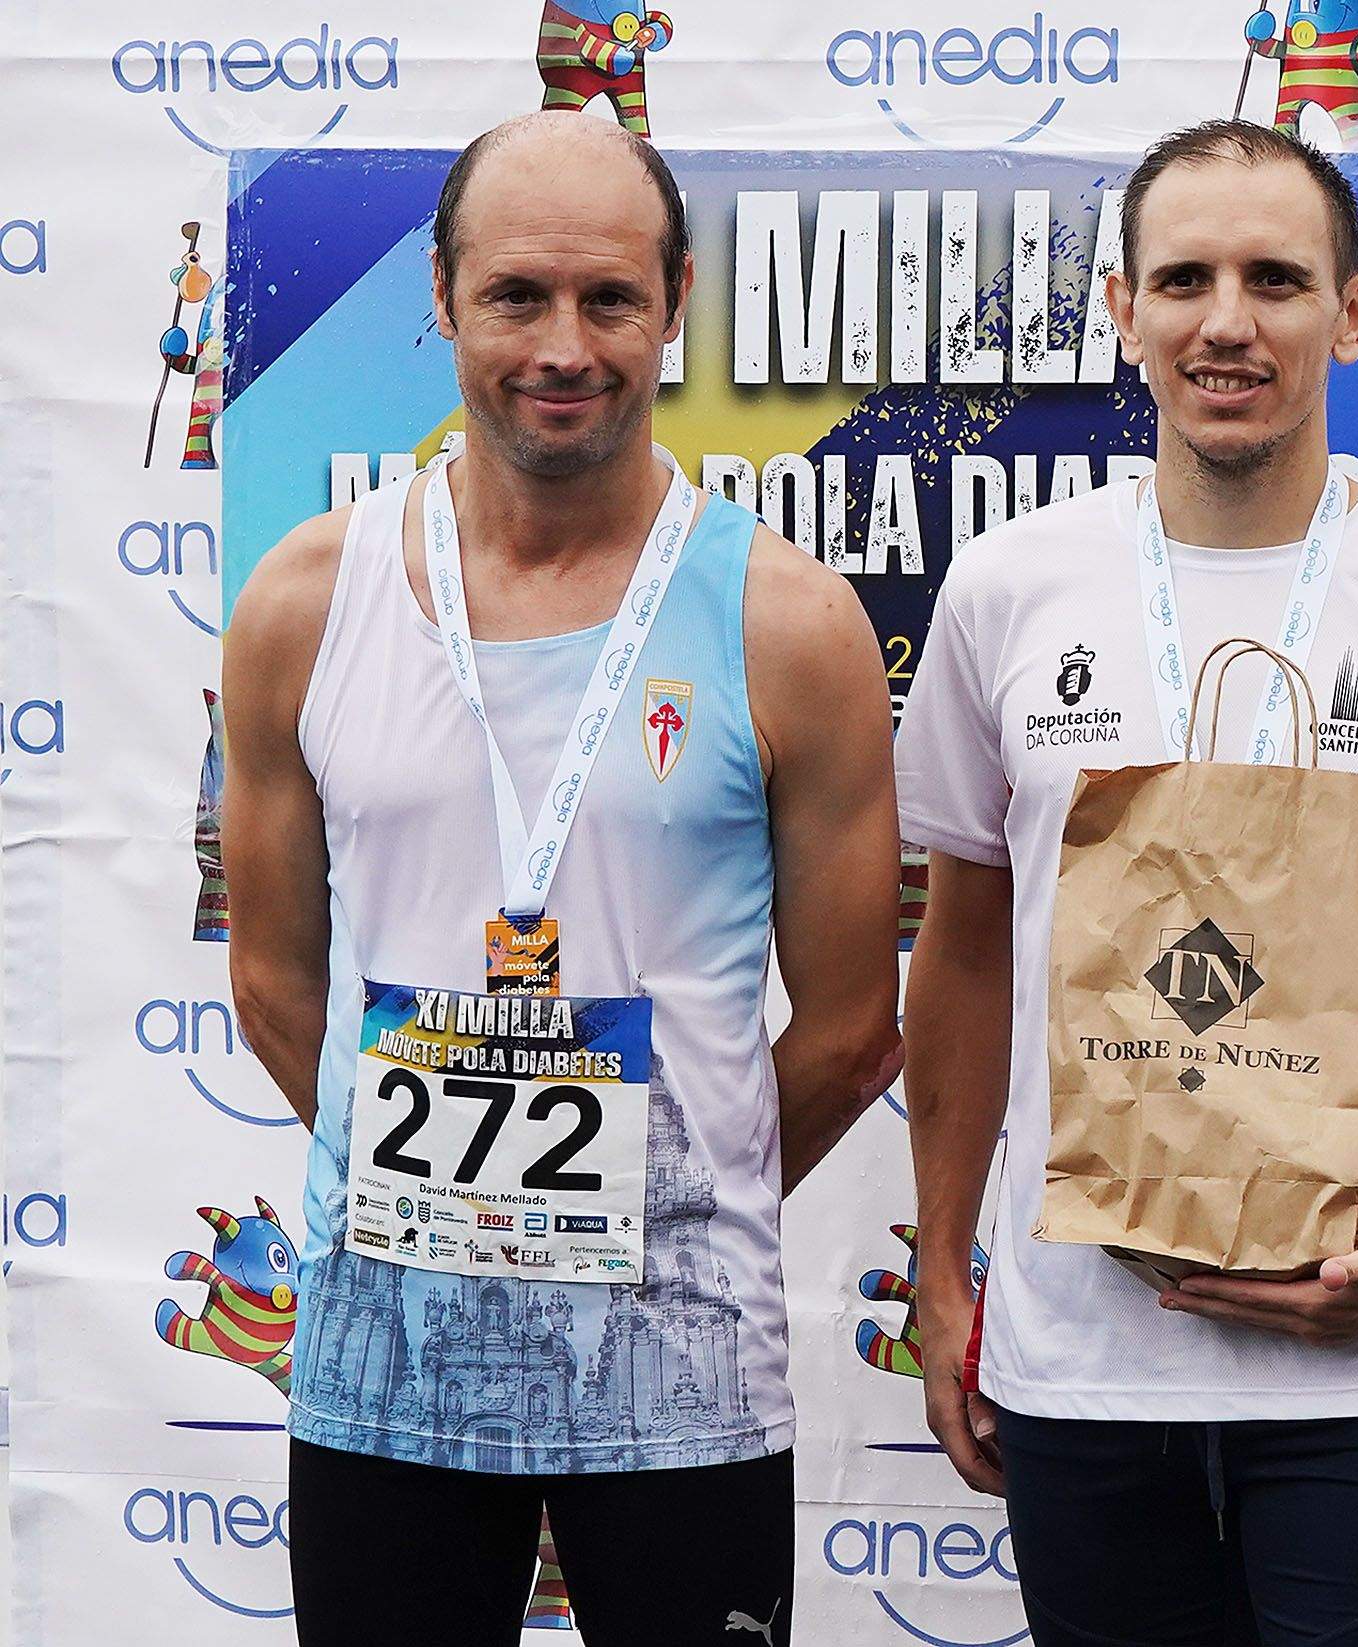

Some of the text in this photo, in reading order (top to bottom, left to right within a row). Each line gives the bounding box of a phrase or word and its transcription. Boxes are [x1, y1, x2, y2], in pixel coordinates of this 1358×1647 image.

[111, 23, 399, 93] anedia
[826, 12, 1119, 87] anedia
[660, 520, 683, 564] anedia
[1301, 538, 1322, 584] anedia
[438, 568, 454, 615] anedia
[635, 579, 661, 627] anedia
[1158, 581, 1172, 627] anedia
[1283, 601, 1304, 648] anedia
[608, 642, 635, 691] anedia
[1166, 643, 1182, 690] anedia
[582, 707, 609, 756] anedia
[1026, 708, 1122, 732] Deputación
[1026, 724, 1120, 750] DA CORUÑA
[557, 773, 581, 823] anedia
[532, 840, 557, 890] anedia
[511, 934, 549, 947] MILLA
[504, 960, 549, 971] móvete
[522, 973, 550, 985] pola
[1158, 948, 1252, 1008] TN
[498, 983, 551, 996] diabetes
[415, 989, 575, 1039] XI MILLA
[377, 1026, 623, 1077] MÓVETE POLA DIABETES
[1079, 1035, 1321, 1075] TORRE DE NUÑEZ
[372, 1067, 603, 1192] 272
[419, 1183, 547, 1206] David Martínez Mellado
[477, 1212, 514, 1227] FROIZ
